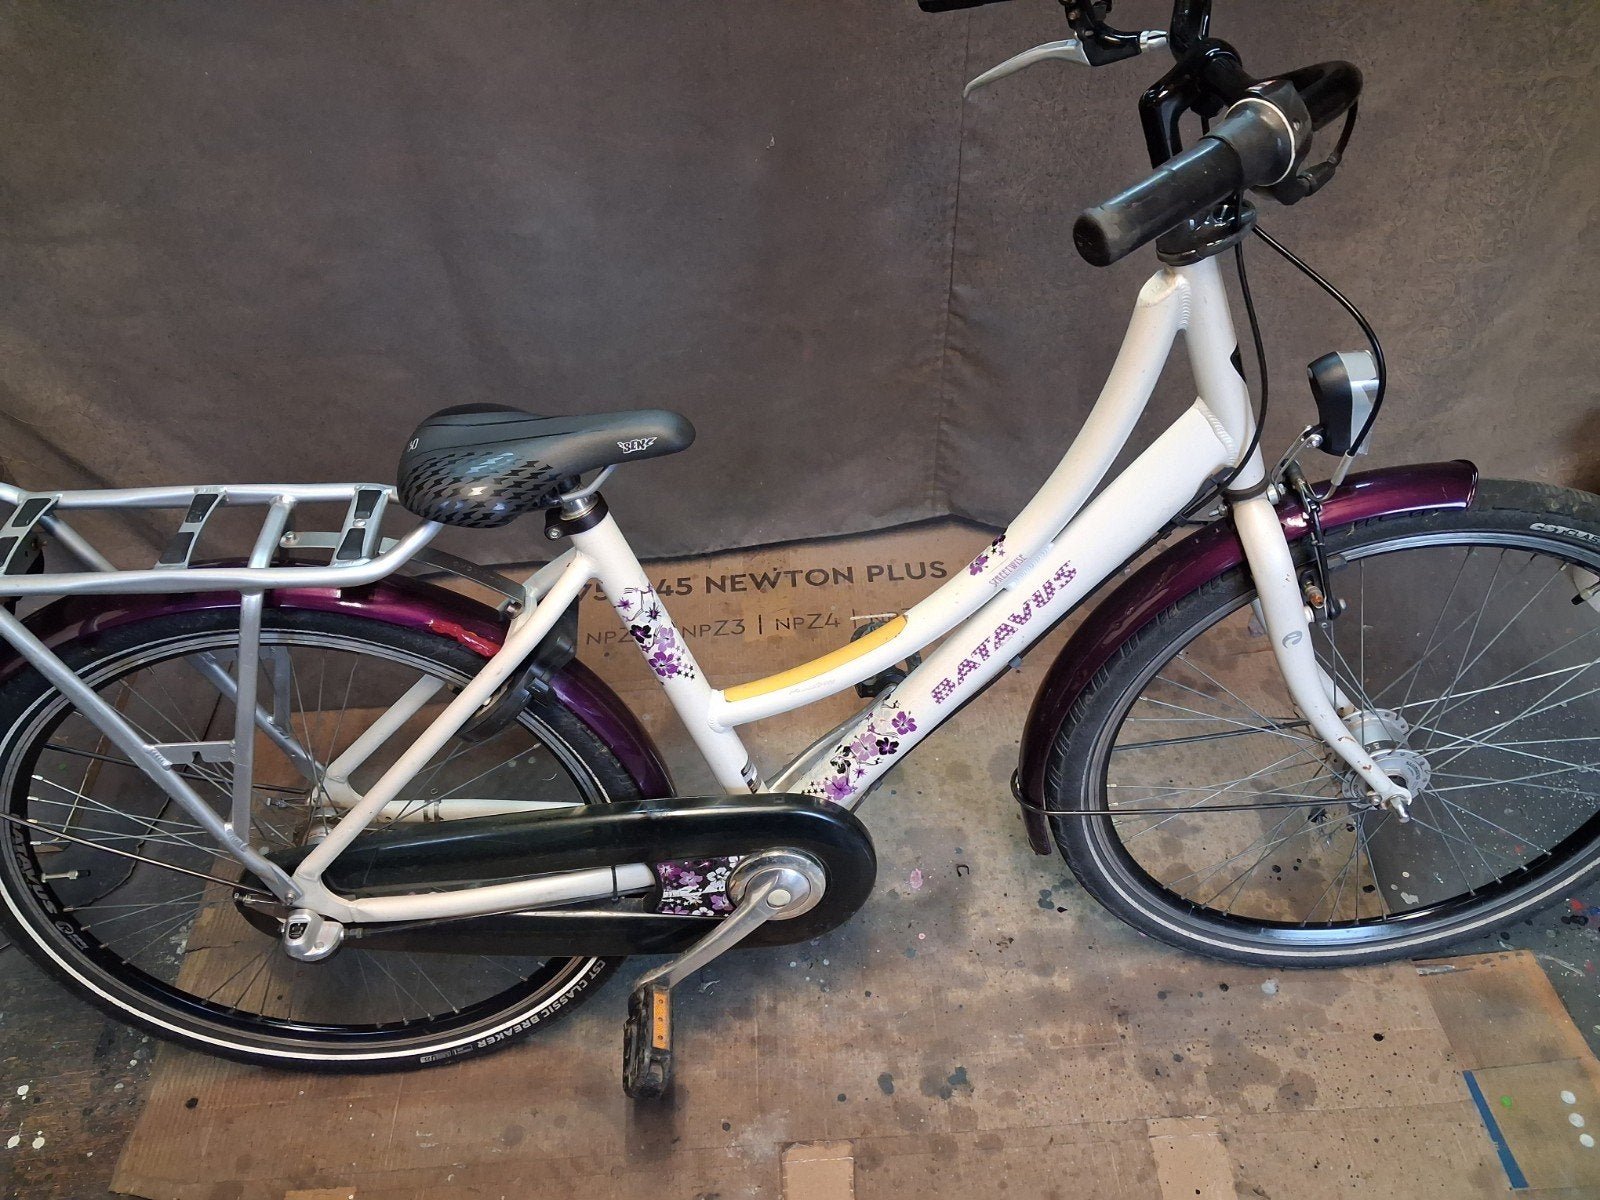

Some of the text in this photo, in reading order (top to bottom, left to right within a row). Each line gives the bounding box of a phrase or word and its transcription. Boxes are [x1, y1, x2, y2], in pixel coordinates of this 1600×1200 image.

[655, 577, 693, 597] 45
[705, 566, 854, 594] NEWTON
[866, 560, 948, 583] PLUS
[586, 627, 634, 645] NPZ
[681, 618, 746, 638] NPZ3
[775, 612, 841, 631] NPZ4
[931, 560, 1077, 704] BATAVUS
[477, 959, 606, 1049] CST CLASSIC BREAKER
